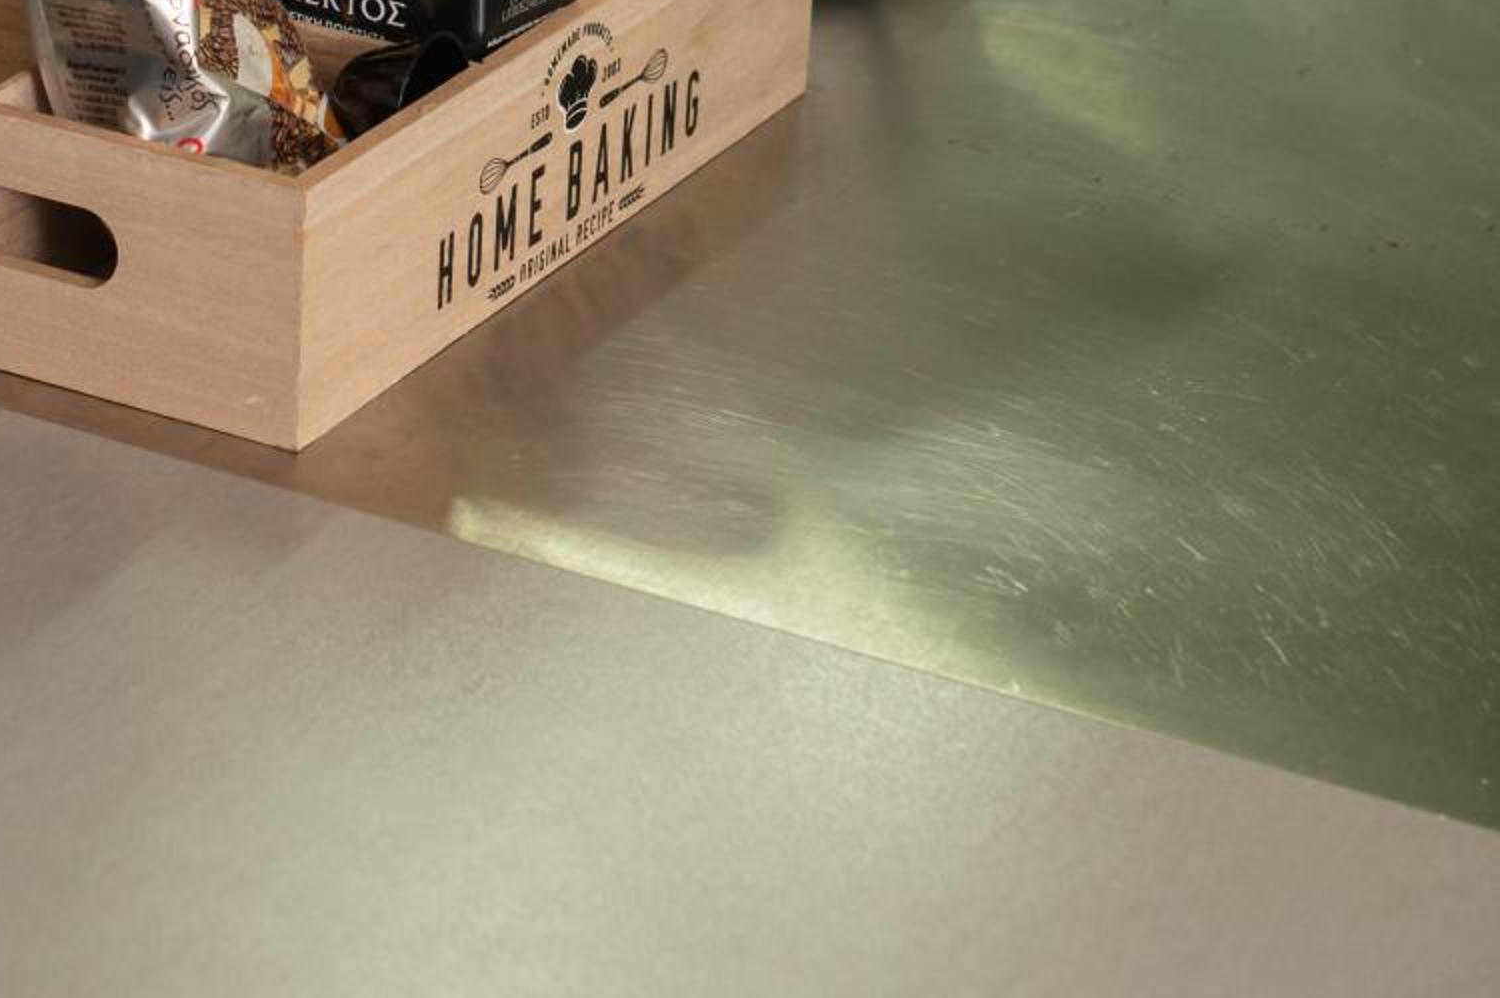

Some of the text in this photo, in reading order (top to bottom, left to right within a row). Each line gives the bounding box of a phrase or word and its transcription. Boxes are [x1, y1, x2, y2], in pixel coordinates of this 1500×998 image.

[436, 69, 700, 311] HOME BAKING
[519, 201, 616, 283] ORIGINAL RECIPE
